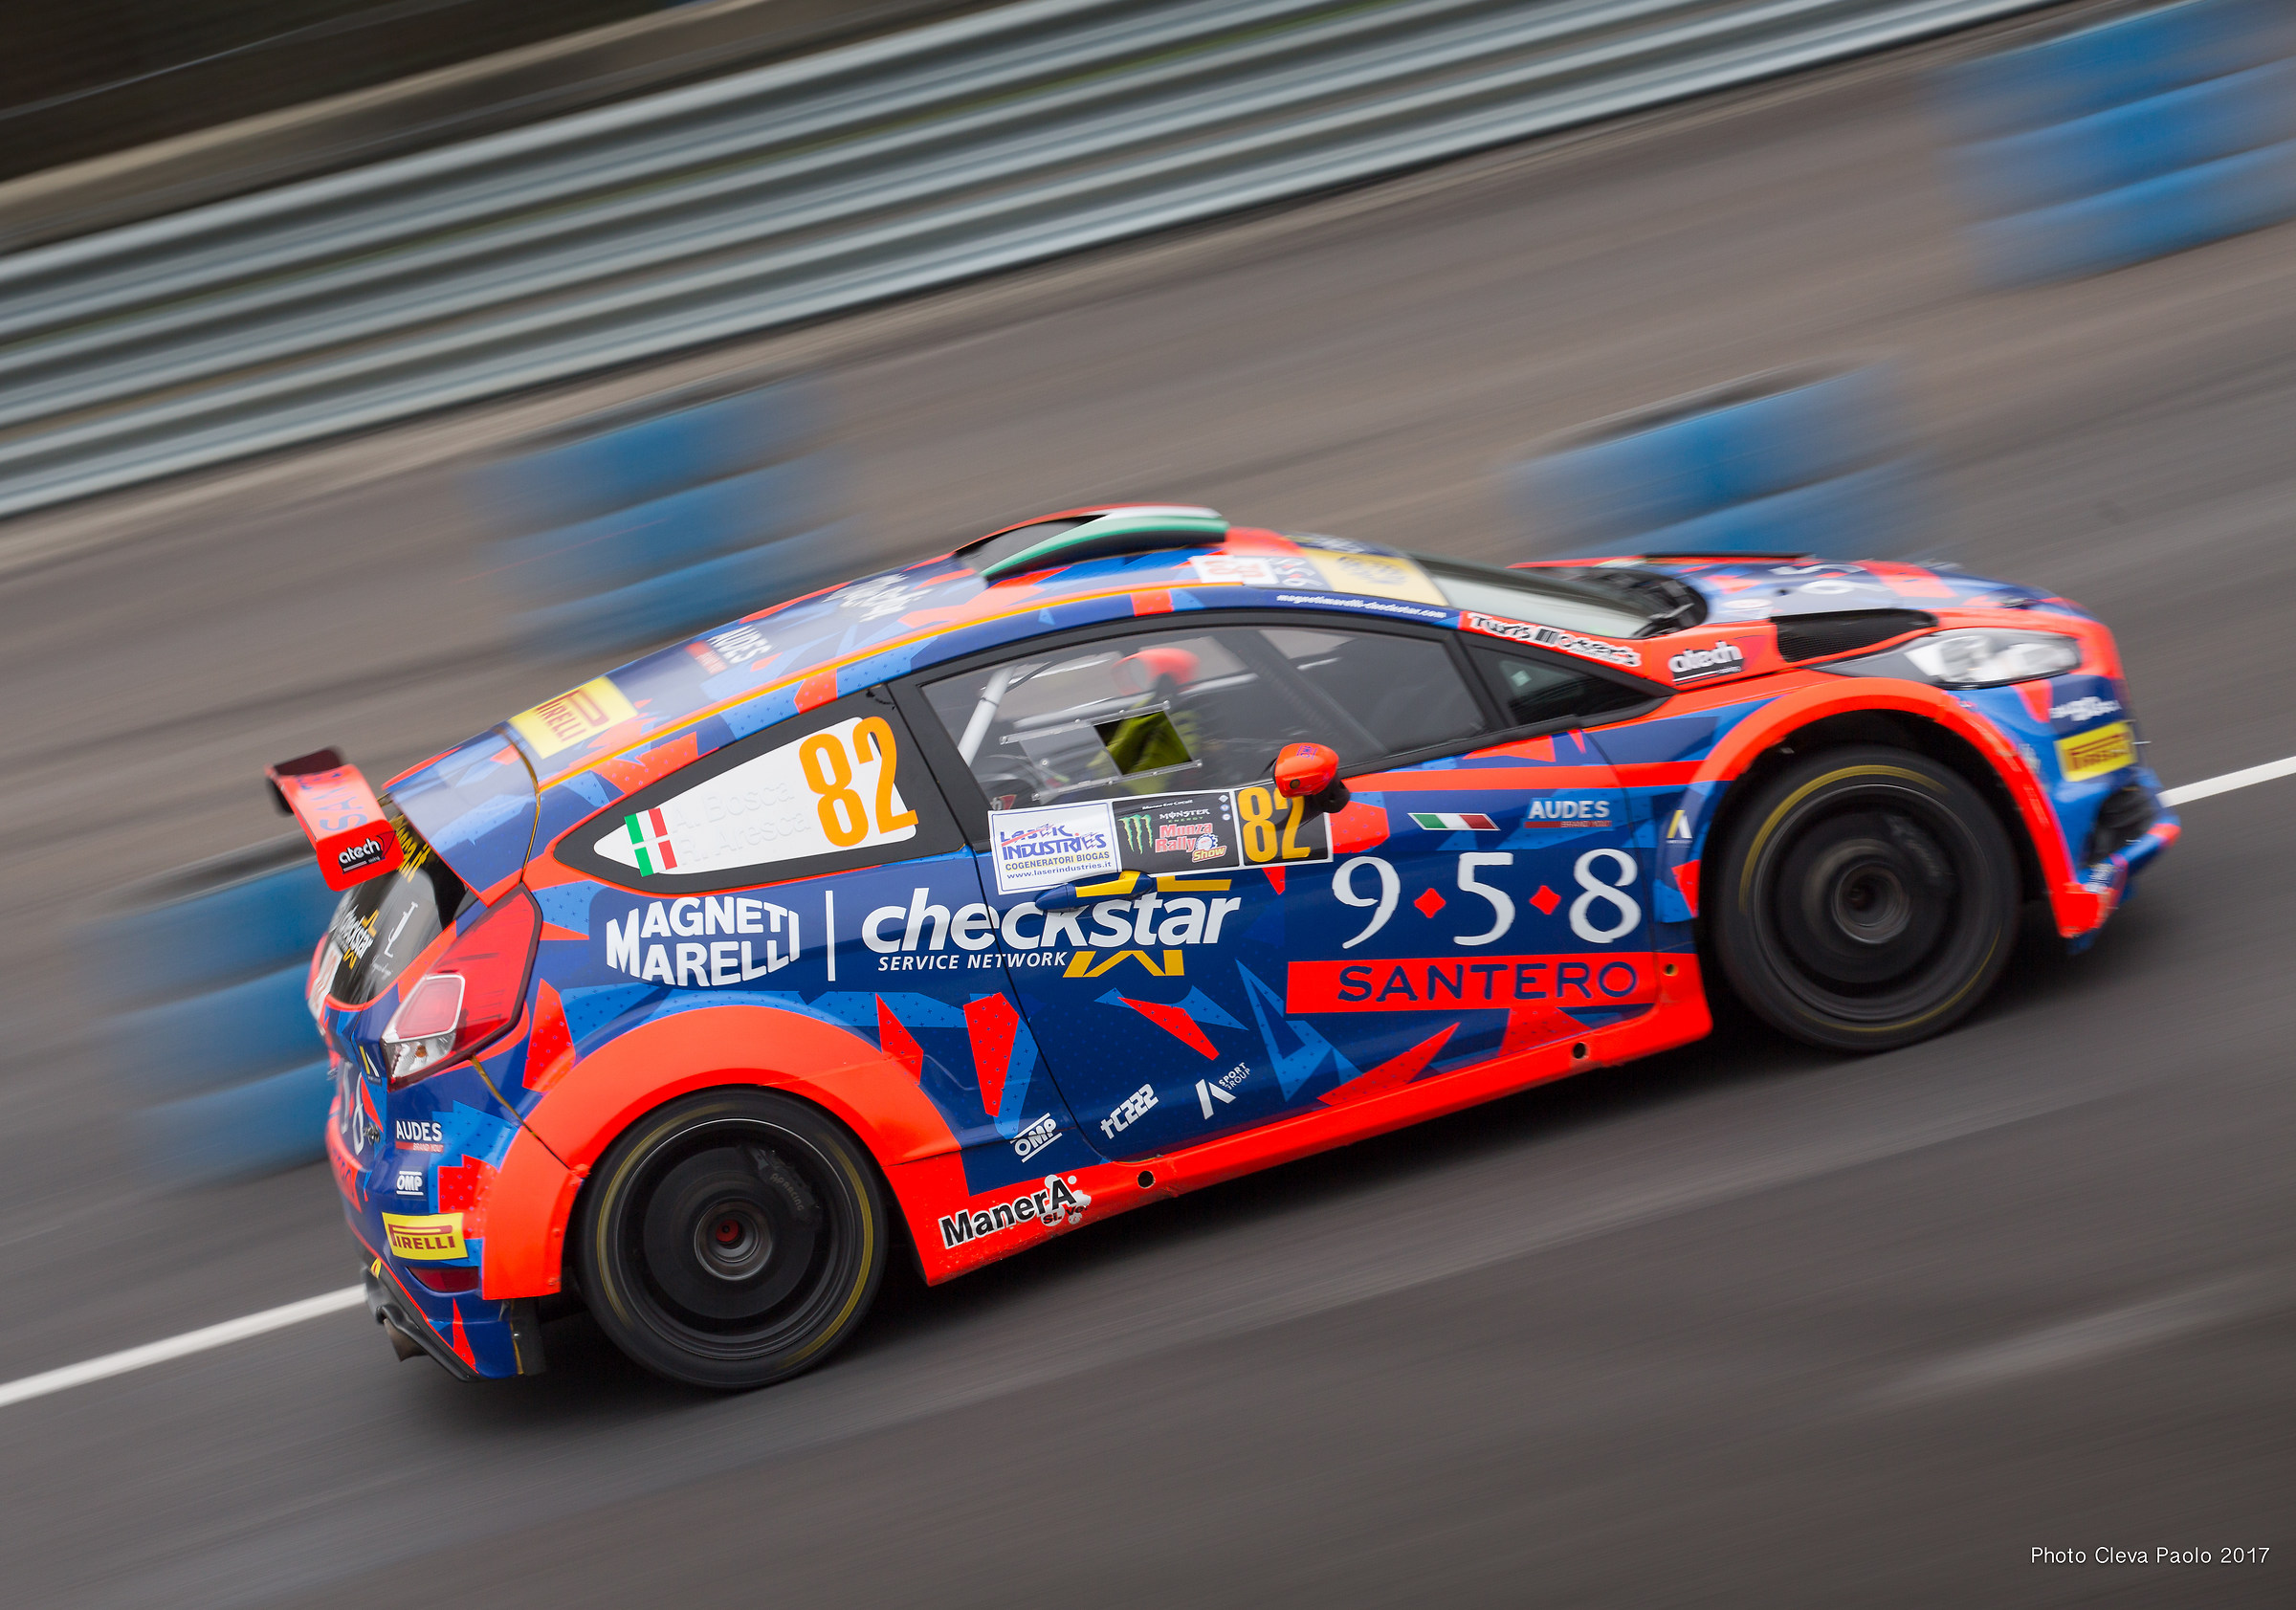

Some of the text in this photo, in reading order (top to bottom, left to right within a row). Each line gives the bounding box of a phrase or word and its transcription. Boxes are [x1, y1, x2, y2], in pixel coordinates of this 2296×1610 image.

[798, 716, 919, 848] 82
[702, 782, 795, 824] Bosca
[1528, 800, 1611, 820] AUDES
[716, 813, 812, 856] Aresca
[1159, 823, 1214, 838] Monza
[1237, 786, 1312, 863] 82
[339, 838, 381, 864] atech
[1155, 835, 1197, 853] Rally
[1192, 846, 1226, 863] Show
[1005, 851, 1110, 871] COGENERATORI BIOGAS
[1006, 861, 1112, 879] www.laserindustries.it
[1331, 848, 1643, 950] 9 5 8
[607, 896, 800, 959] MAGNETI
[862, 887, 1242, 954] checkstar
[607, 922, 800, 987] MARELLI
[877, 951, 1069, 972] SERVICE NETWORK
[1336, 960, 1640, 1003] SANTERO
[1218, 1062, 1247, 1088] SPORT
[396, 1119, 444, 1142] AUDES
[1012, 1116, 1058, 1158] OMP
[396, 1173, 424, 1193] OMP
[940, 1178, 1077, 1247] ManerA
[387, 1224, 456, 1250] PIRELLI
